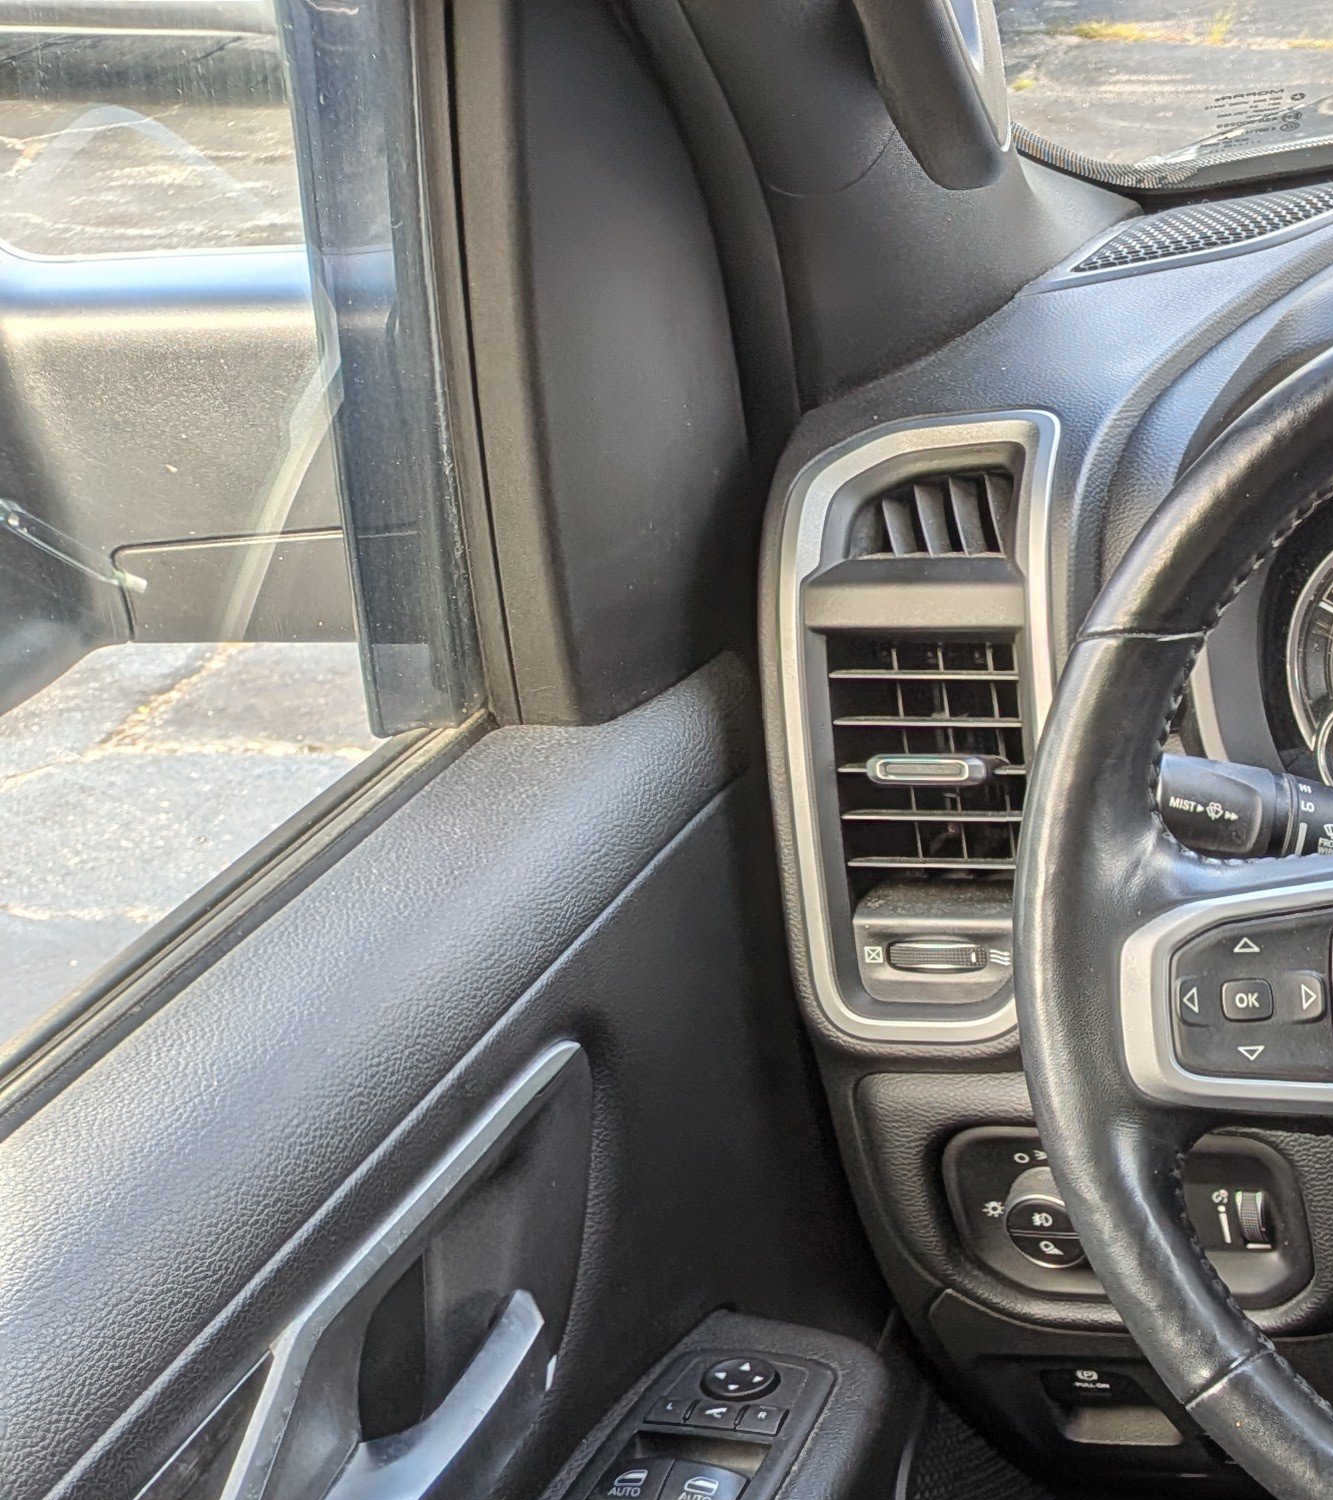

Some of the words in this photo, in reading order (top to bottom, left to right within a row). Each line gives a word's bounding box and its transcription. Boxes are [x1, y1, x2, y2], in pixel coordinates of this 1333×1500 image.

[1169, 796, 1197, 813] MIST
[1301, 800, 1315, 813] LO
[1234, 992, 1260, 1008] OK
[607, 1486, 640, 1498] AUTO
